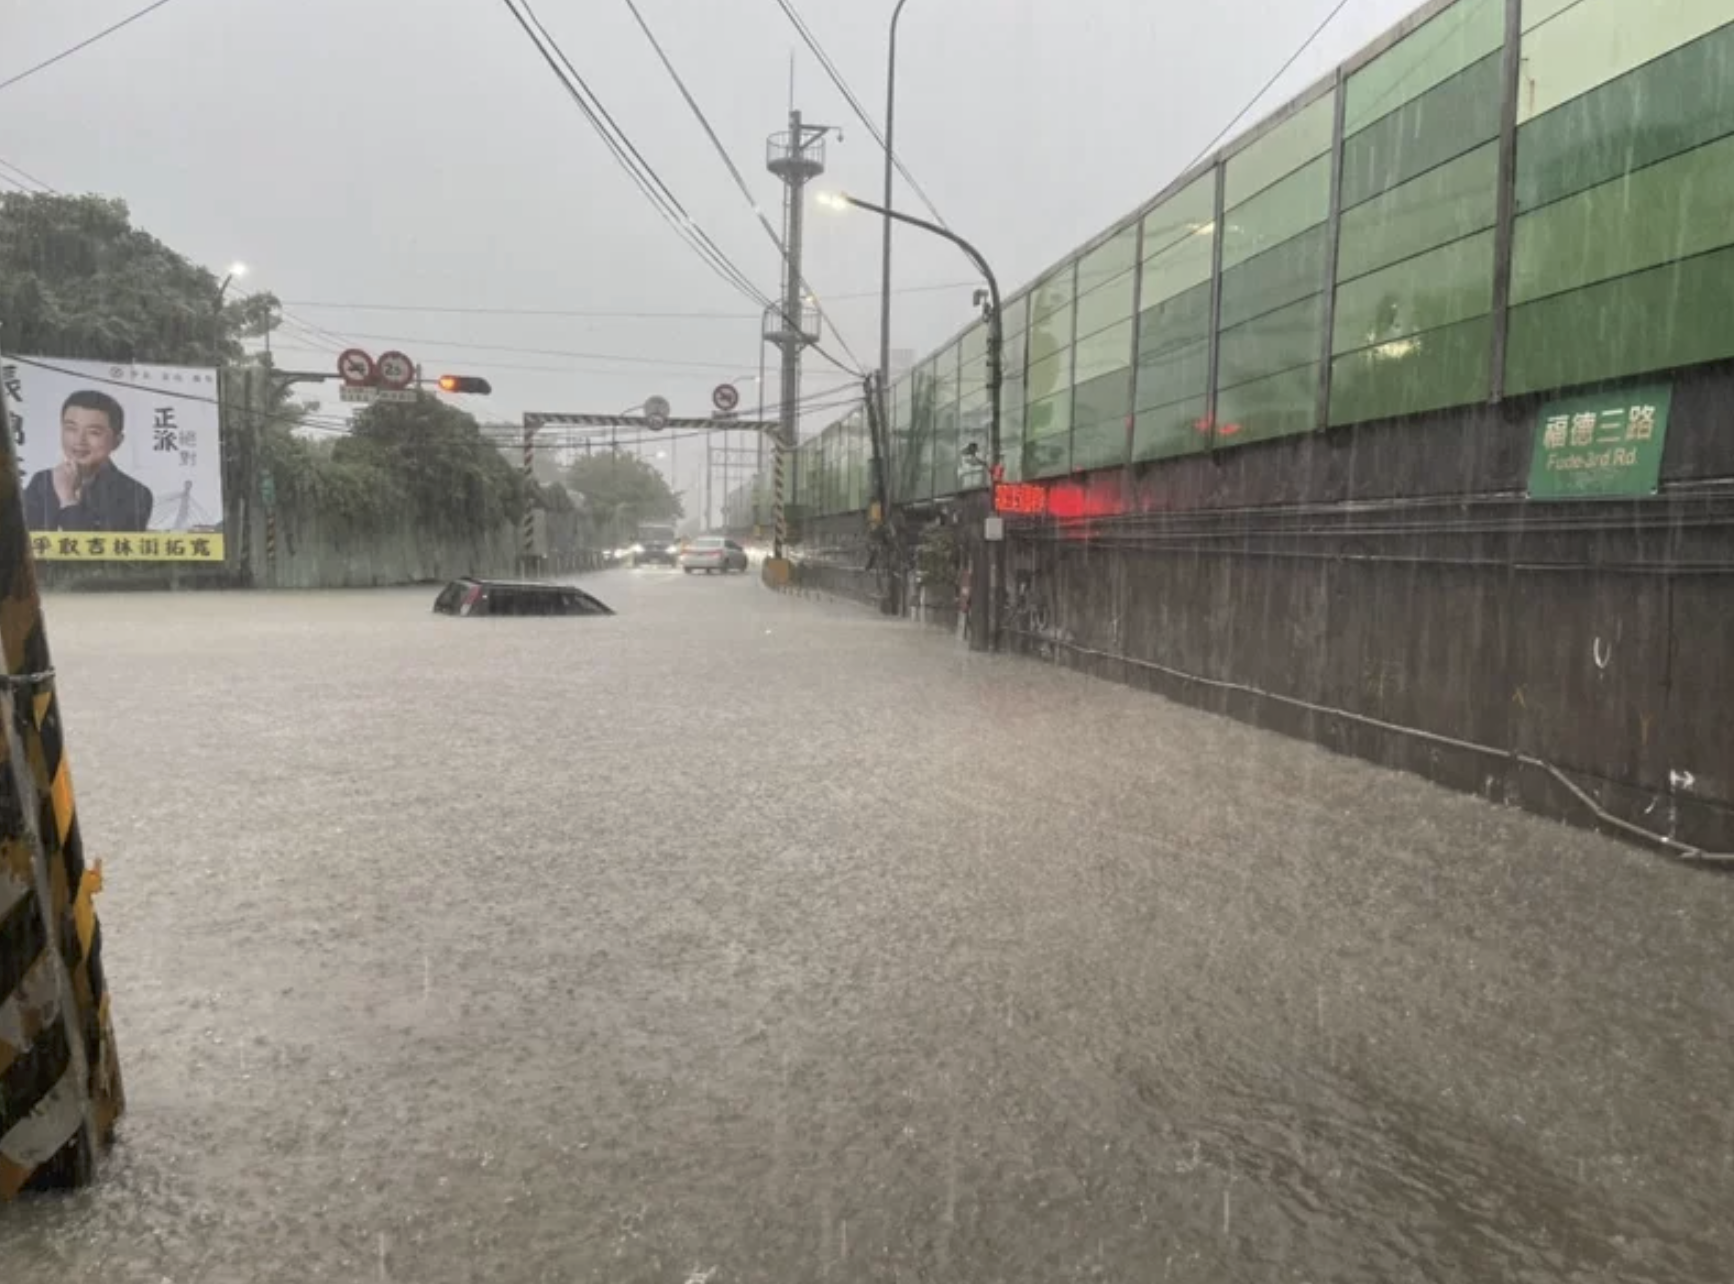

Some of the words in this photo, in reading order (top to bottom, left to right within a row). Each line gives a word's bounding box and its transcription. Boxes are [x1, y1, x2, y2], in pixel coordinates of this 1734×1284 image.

[153, 406, 178, 453] 正派
[1543, 405, 1655, 449] 福德三路
